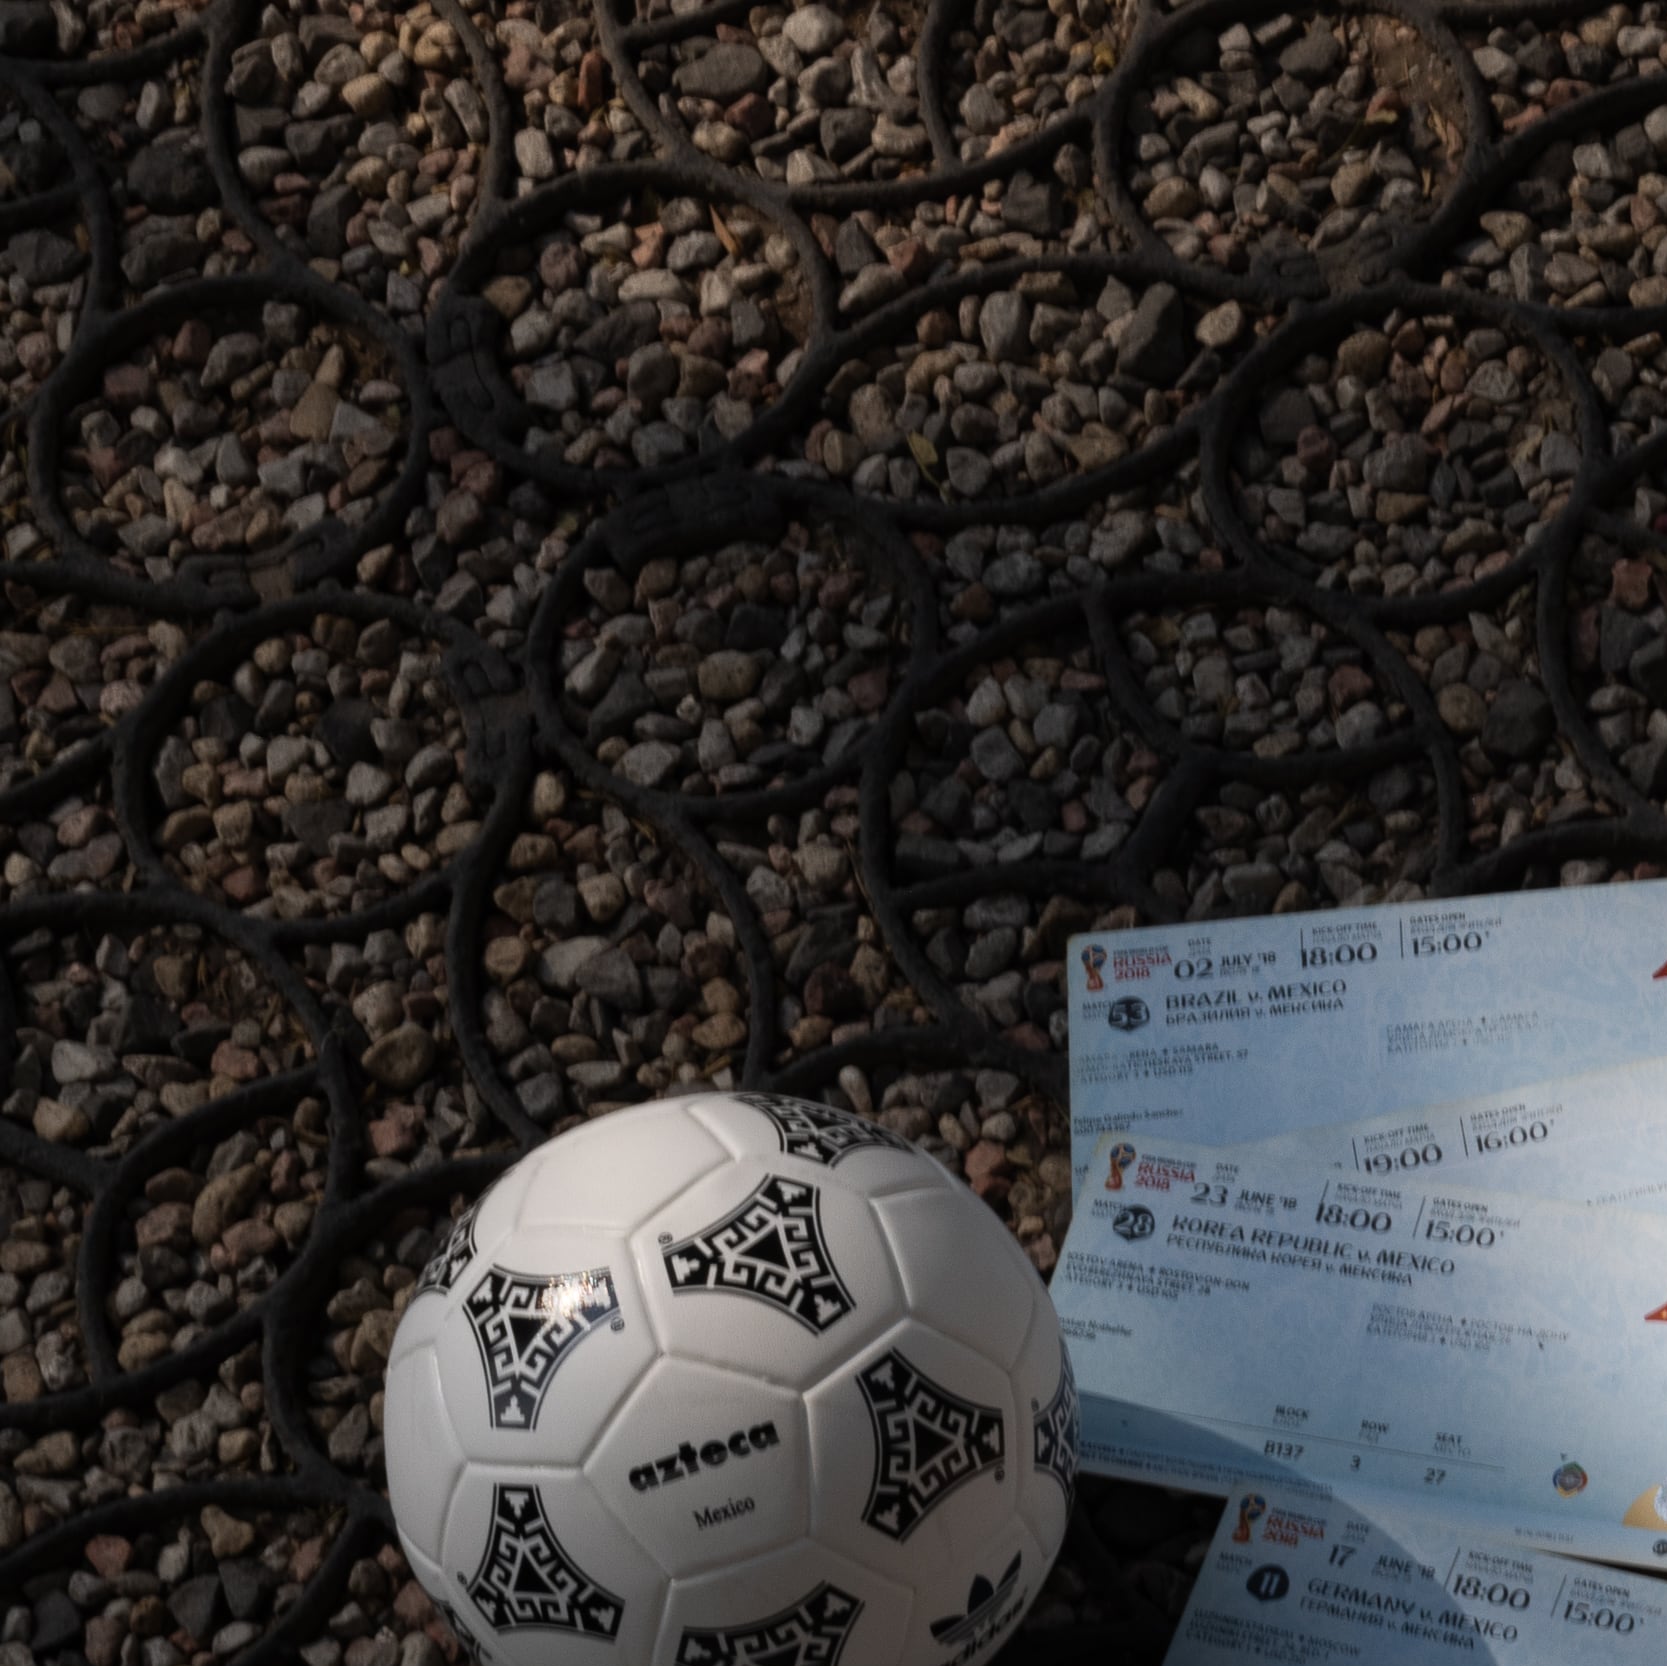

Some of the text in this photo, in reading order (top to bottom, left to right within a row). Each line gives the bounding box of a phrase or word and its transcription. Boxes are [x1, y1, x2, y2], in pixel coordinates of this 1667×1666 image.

[1113, 953, 1172, 969] RUSSIA
[1174, 953, 1252, 980] 02 JULY
[1302, 942, 1377, 969] 18:00
[1114, 967, 1150, 982] 2018
[1166, 978, 1347, 1010] BRAZIL MEXICO
[1138, 1162, 1195, 1184] RUSSIA
[1365, 1143, 1442, 1176] 19:00
[1190, 1182, 1276, 1206] 23 JUNE
[1315, 1202, 1392, 1233] 18:00
[1172, 1213, 1455, 1276] KOREA REPUBLIC MEXICO
[628, 1420, 779, 1493] azteca
[693, 1494, 757, 1532] Mexico
[1267, 1514, 1325, 1540] RUSSIA
[1328, 1544, 1414, 1573] 17 JUNE
[1453, 1573, 1531, 1610] 18:00
[1307, 1577, 1519, 1643] GERMANY MEXICO
[1564, 1600, 1635, 1635] 15:00
